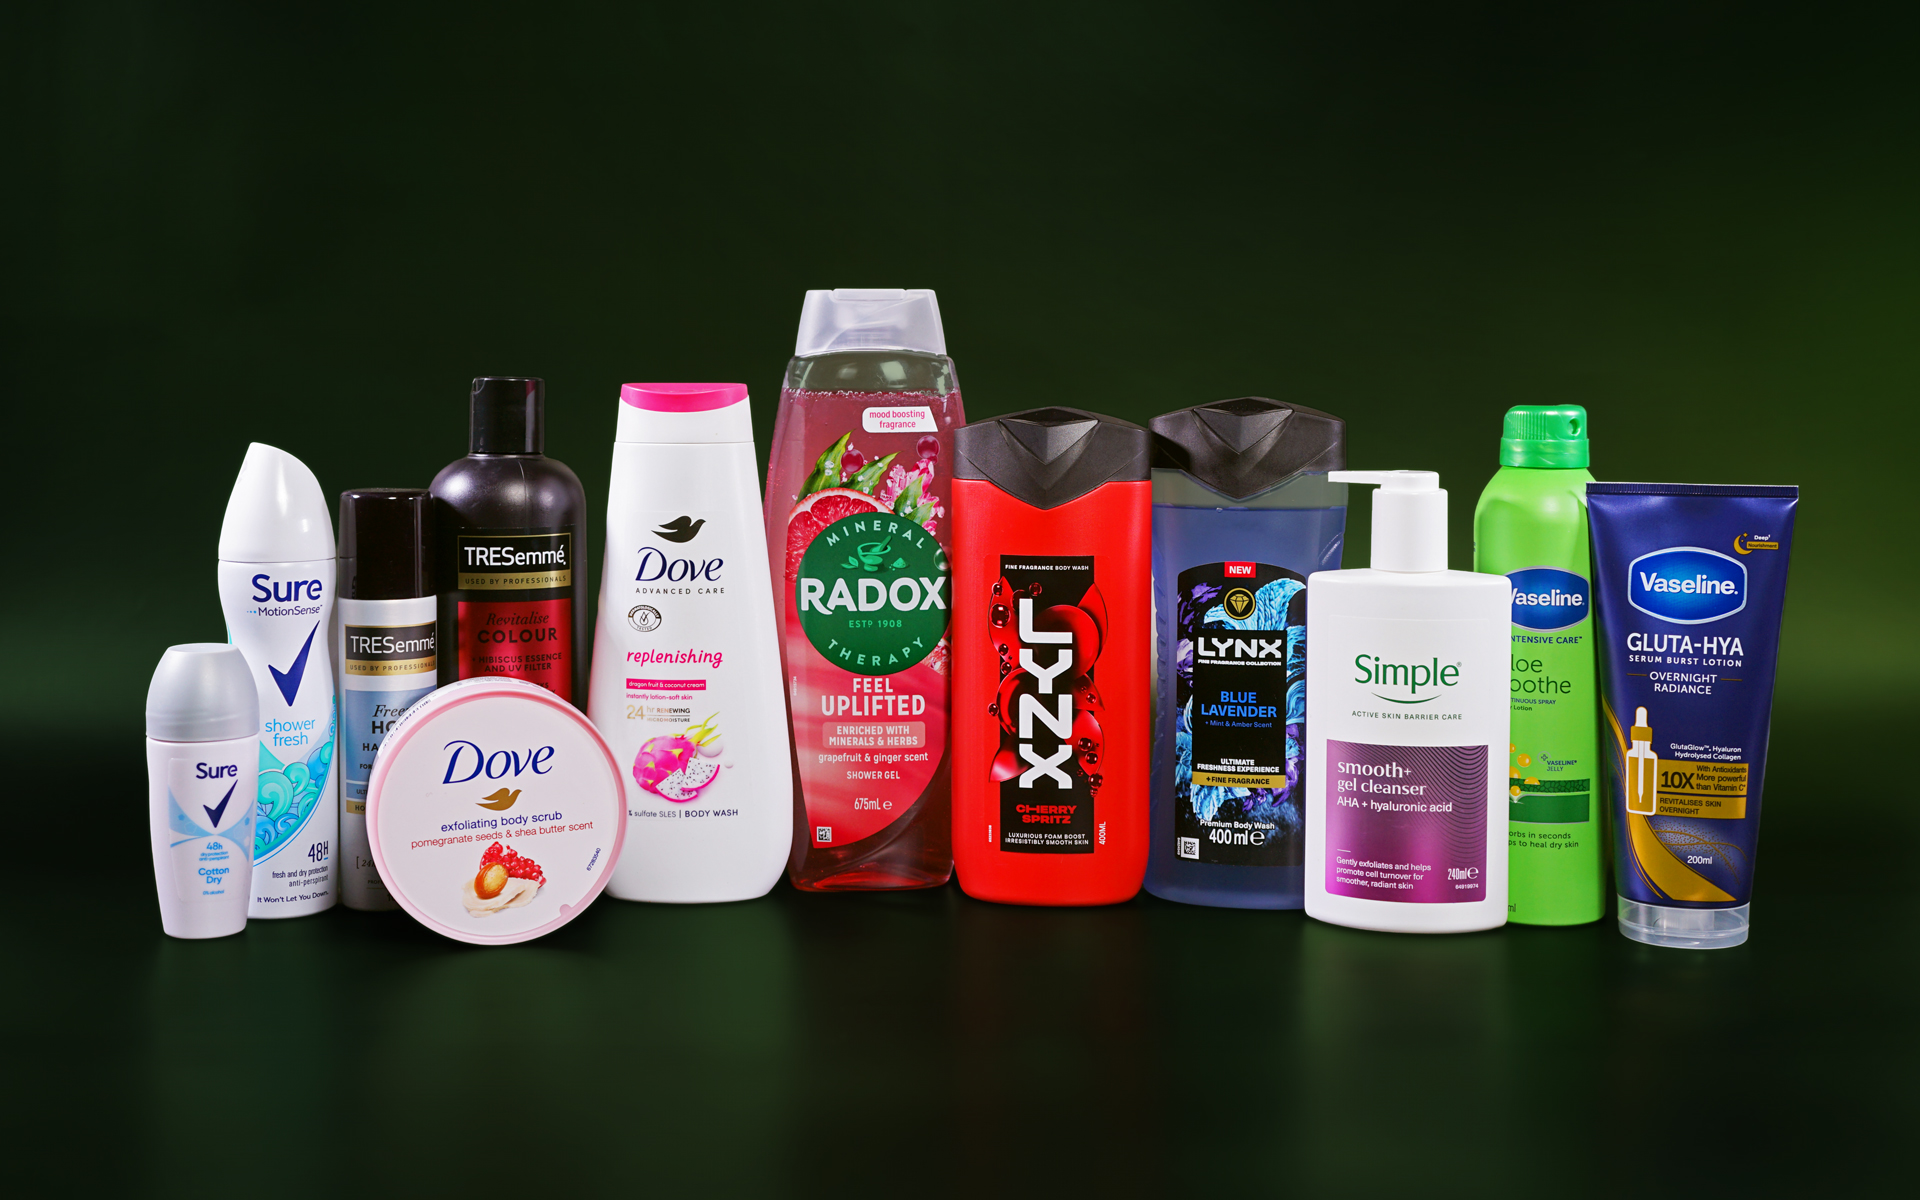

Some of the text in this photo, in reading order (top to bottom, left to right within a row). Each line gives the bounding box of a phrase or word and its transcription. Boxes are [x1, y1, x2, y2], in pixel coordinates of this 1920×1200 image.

[869, 410, 926, 420] mood boosting
[879, 420, 917, 430] fragrance
[826, 520, 925, 548] MINERAL
[635, 546, 724, 582] Dove
[1229, 566, 1252, 575] NEW
[503, 575, 567, 585] PROFESSIONALS
[251, 573, 323, 603] Sure
[635, 587, 725, 595] ADVANCED CARE
[800, 576, 947, 615] RADOX
[485, 611, 550, 626] Revitalise
[877, 619, 902, 628] 1908
[477, 627, 558, 644] COLOUR
[1511, 635, 1554, 644] NTENSIVE
[1198, 637, 1282, 658] LYNX
[1626, 632, 1744, 657] GLUTA-HYA
[828, 636, 924, 667] THERAPY
[478, 652, 563, 664] HIBISCUS ESSENCE
[626, 648, 724, 669] replenishing
[1510, 653, 1543, 673] loe
[1629, 655, 1743, 668] SERUM BURST LOTION
[349, 664, 367, 672] USED
[484, 662, 552, 673] AND UV FILTER
[1649, 671, 1718, 684] OVERNIGHT
[853, 677, 894, 693] FEEL
[1510, 676, 1571, 694] oothe
[1653, 682, 1712, 695] RADIANCE
[626, 692, 650, 701] instantly
[1019, 598, 1073, 789] LYNX
[1220, 690, 1257, 704] BLUE
[821, 694, 926, 716] UPLIFTED
[1201, 703, 1278, 718] LAVENDER
[626, 704, 646, 720] 24
[1352, 710, 1379, 719] ACTIVE
[1381, 712, 1401, 720] SKIN
[1441, 713, 1463, 721] CARE
[265, 718, 316, 733] shower
[836, 725, 910, 735] ENRICHED WITH
[272, 732, 309, 747] fresh
[828, 735, 919, 746] MINERALS HERBS
[1712, 745, 1742, 754] Hyaluron
[442, 739, 556, 785] Dove
[818, 752, 929, 764] grapefruit ginger scent
[1220, 758, 1255, 766] ULTIMATE
[1674, 751, 1742, 762] Hydrolysed Collagen
[195, 762, 238, 779] Sure
[1197, 763, 1280, 773] FRESHNESS EXPERIENCE
[1696, 764, 1748, 773] With Antioxidants
[846, 770, 901, 780] SHOWER GEL
[1227, 777, 1270, 785] FRAGRANCE
[1660, 770, 1747, 790] 10X More powerful
[1337, 777, 1427, 796] gel cleanser
[1696, 782, 1737, 792] than Vitamin
[1336, 796, 1453, 813] AHA hyaluronic acid
[1659, 797, 1722, 808] REVITALISES SKIN
[634, 808, 739, 818] sulfate SLES BODY WASH
[1016, 804, 1077, 814] CHERRY
[1659, 806, 1700, 815] OVERNIGHT
[440, 811, 563, 833] exfoliating body scrub
[1022, 814, 1072, 824] SPRITZ
[1200, 819, 1275, 831] Premium Body Wash
[411, 821, 594, 849] pomegranate seeds shea butter scent
[1098, 821, 1107, 845] 400ML
[1208, 828, 1249, 846] 400 ml
[1538, 832, 1571, 840] seconds
[206, 841, 223, 850] 48h
[1529, 840, 1579, 850] heal dry skin
[1336, 856, 1432, 873] Gently exfoliates and helps
[1686, 855, 1713, 865] 200ml
[197, 867, 230, 876] Cotton
[272, 869, 298, 879] fresh and
[1336, 867, 1424, 881] promote cell turnover for
[1447, 867, 1467, 881] 240ml
[206, 875, 223, 885] Dry
[1370, 880, 1414, 890] radiant skin
[263, 896, 285, 904] Won't
[286, 895, 298, 903] Let
[299, 893, 312, 901] You
